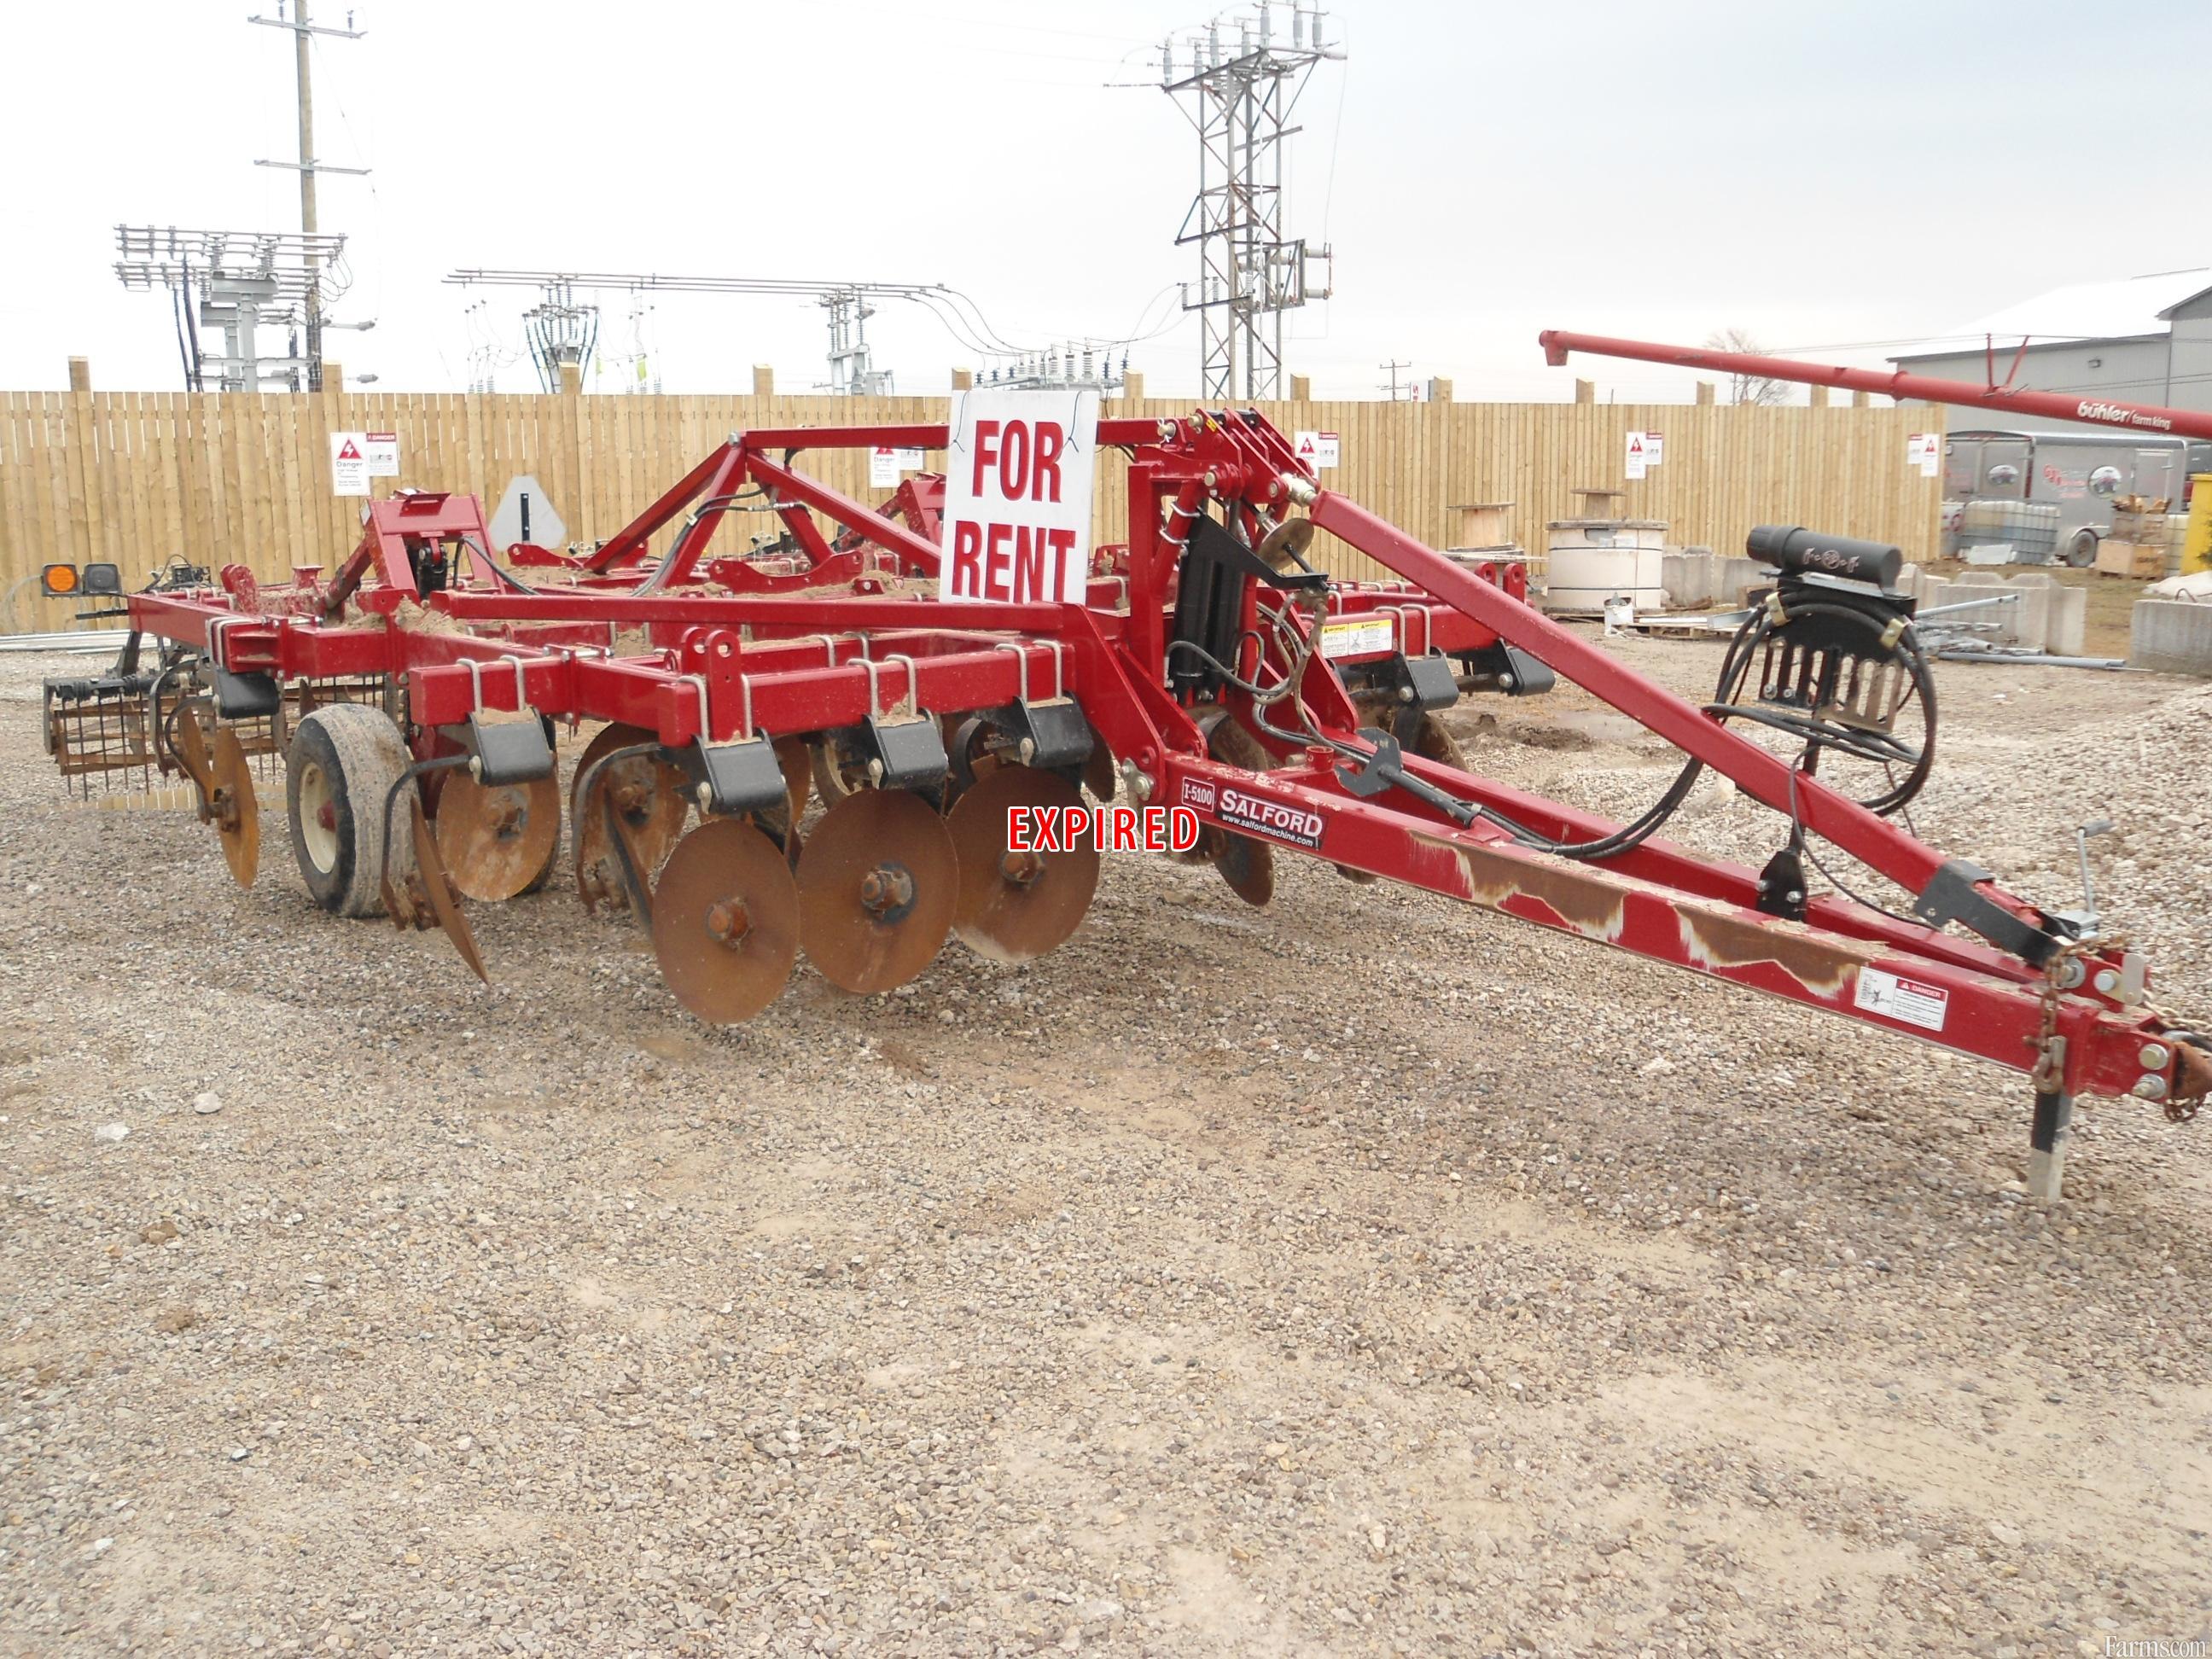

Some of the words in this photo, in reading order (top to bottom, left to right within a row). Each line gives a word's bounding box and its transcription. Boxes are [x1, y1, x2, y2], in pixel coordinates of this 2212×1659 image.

[2152, 416, 2171, 430] king
[972, 419, 1064, 504] FOR
[952, 520, 1076, 604] RENT
[1184, 783, 1213, 806] I-5100
[1220, 789, 1323, 837] SALFORD
[1222, 813, 1313, 847] www.salfordmachine.com
[1912, 985, 1941, 998] DANGER
